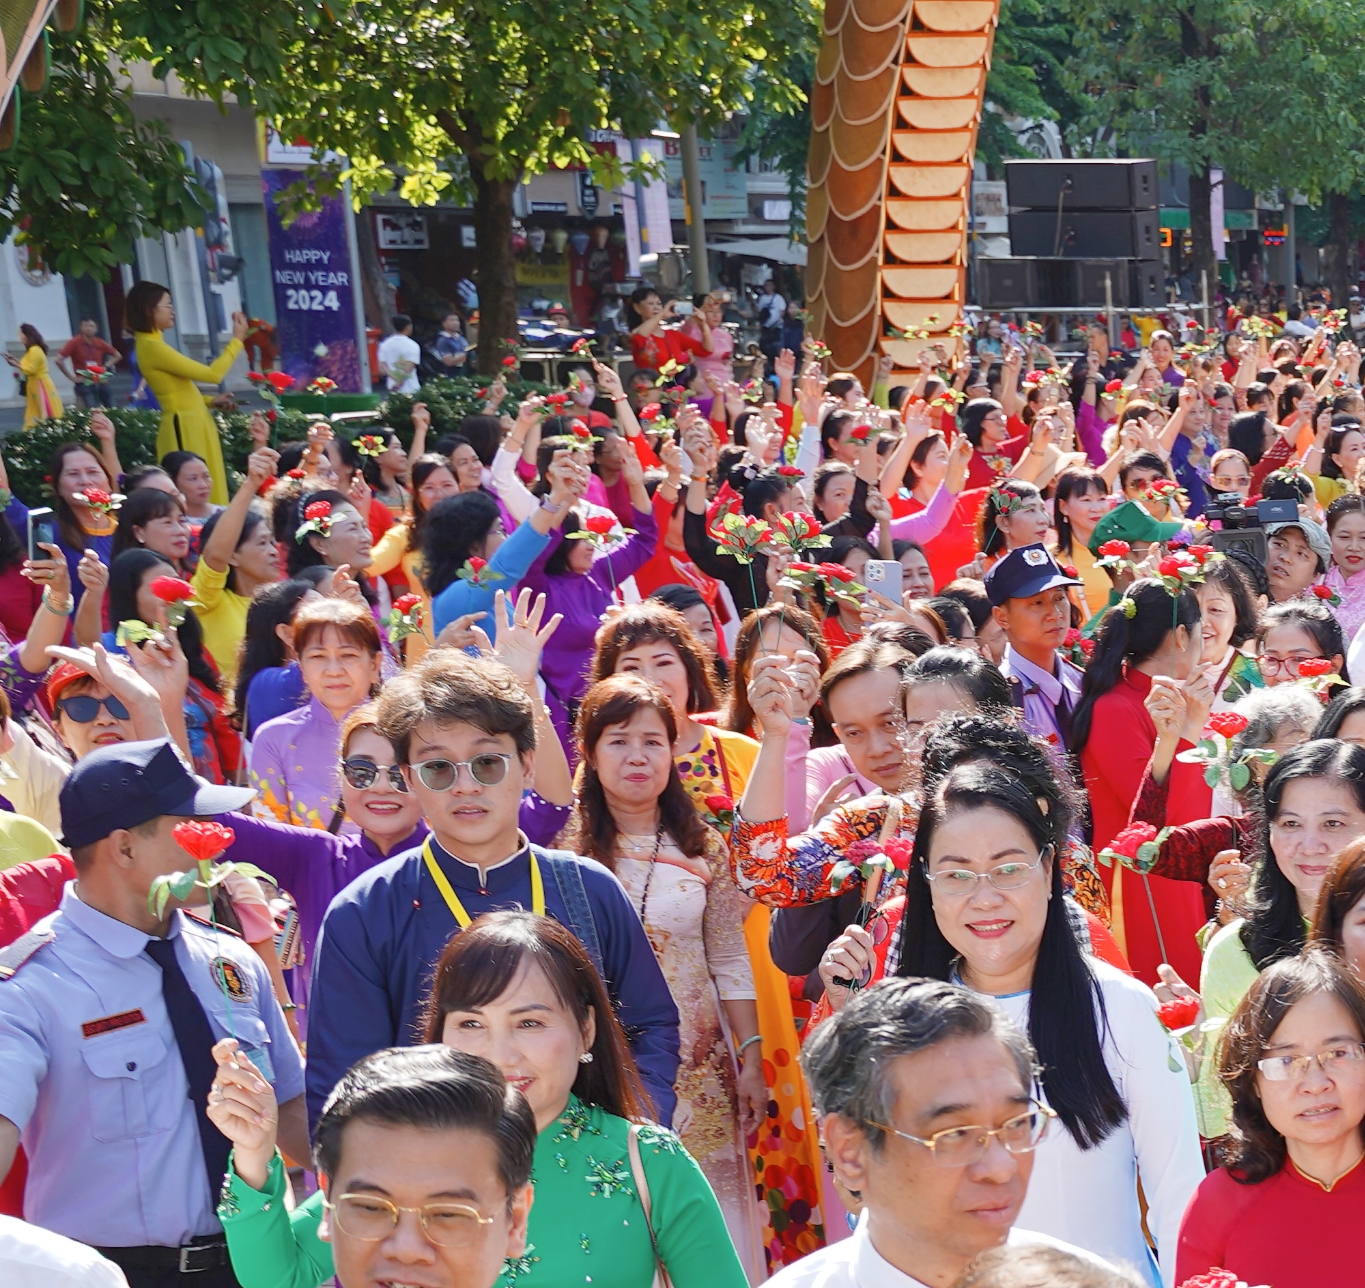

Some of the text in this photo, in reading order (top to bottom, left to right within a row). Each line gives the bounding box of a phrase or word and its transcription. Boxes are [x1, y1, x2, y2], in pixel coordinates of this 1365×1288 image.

[284, 250, 331, 265] HAPPY
[275, 270, 349, 286] NEW YEAR
[286, 289, 341, 311] 2024
